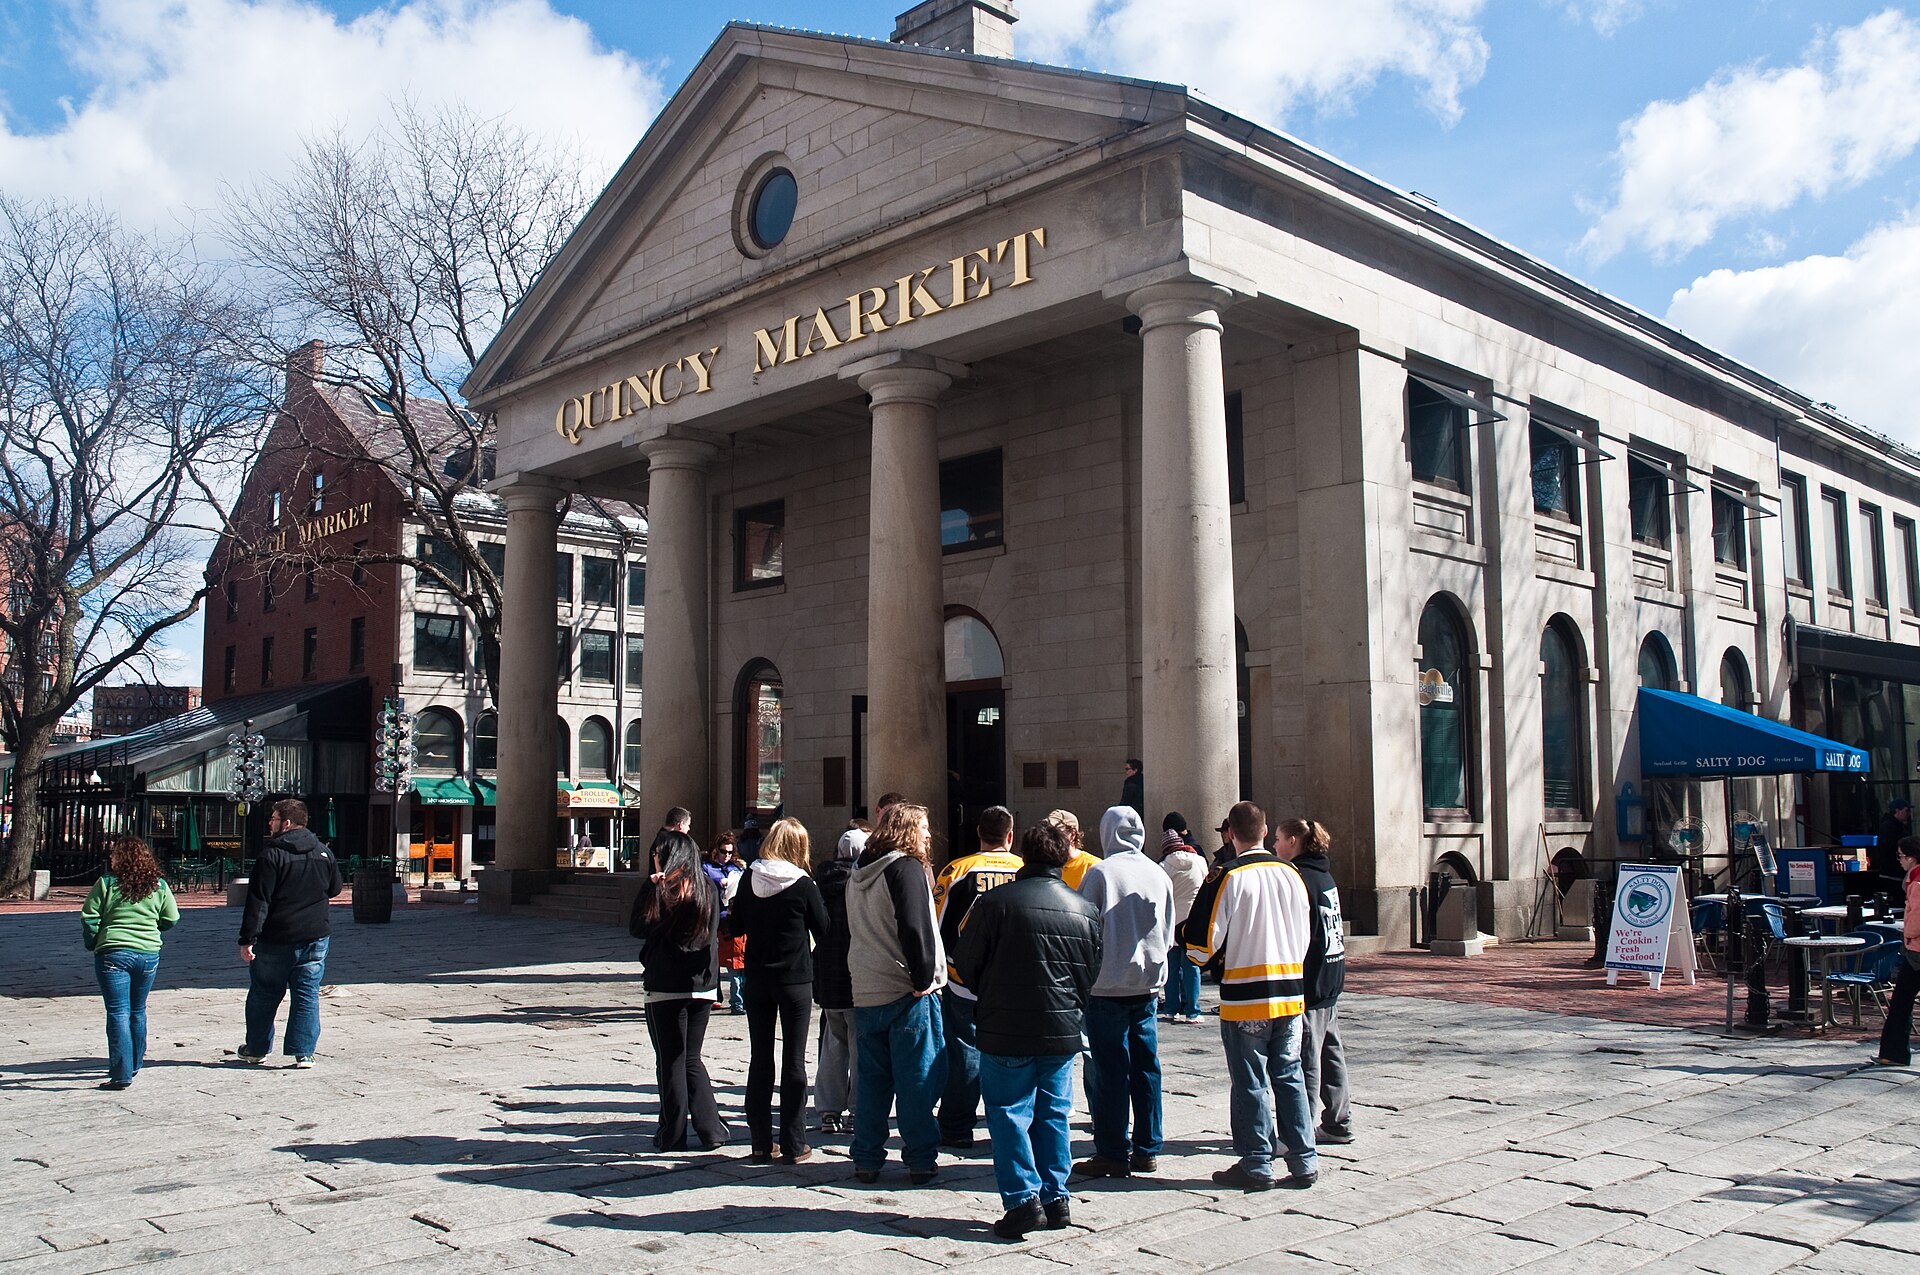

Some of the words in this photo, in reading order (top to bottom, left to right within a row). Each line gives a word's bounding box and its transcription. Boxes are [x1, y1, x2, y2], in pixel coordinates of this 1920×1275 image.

[554, 346, 720, 445] QUINCY
[752, 227, 1046, 374] MARKET
[299, 502, 372, 545] MARKET
[1696, 757, 1732, 768] SALTY
[1737, 756, 1766, 767] DOG
[1825, 752, 1845, 767] SALTY
[1628, 877, 1651, 889] SALTY
[1651, 878, 1665, 891] DOG
[1626, 913, 1639, 924] Fresh
[1639, 914, 1659, 924] Seafood
[1615, 929, 1643, 938] We're
[1615, 945, 1640, 954] Fresh
[1619, 952, 1655, 961] Seafood
